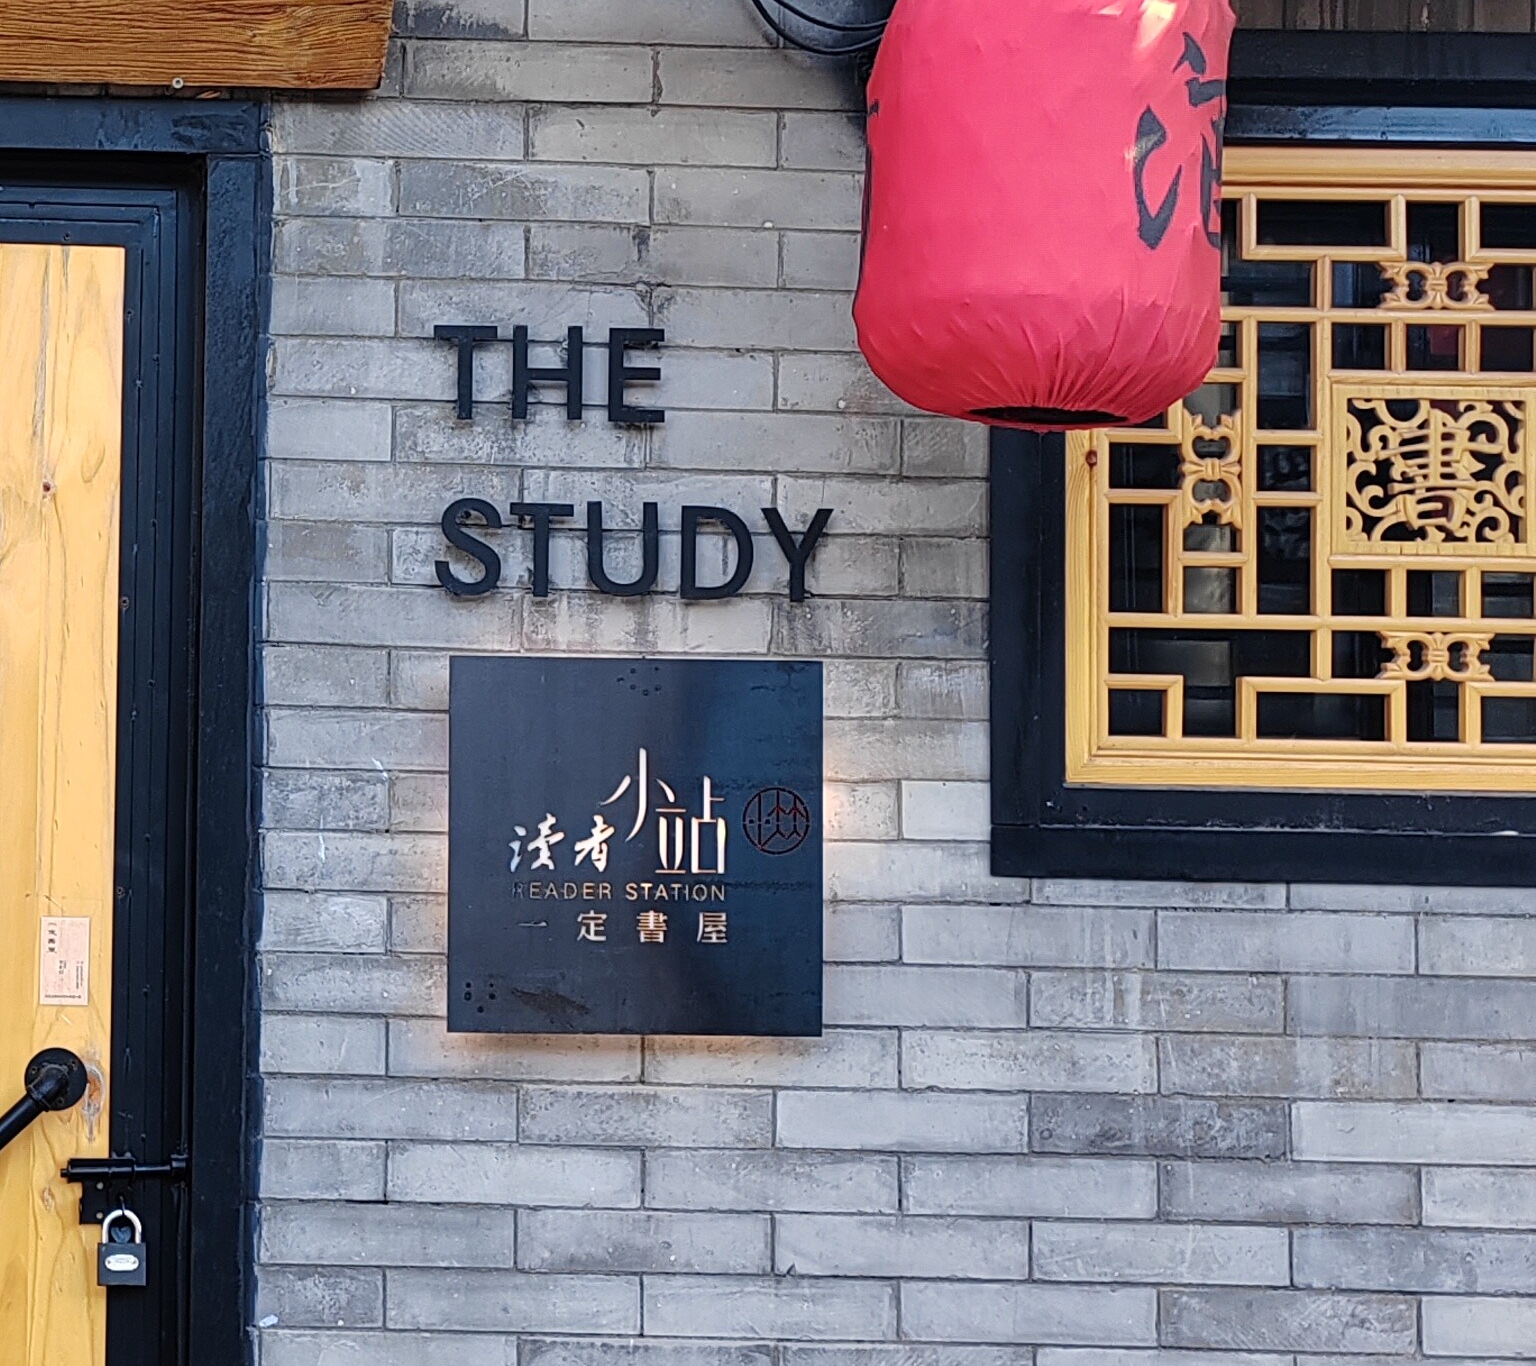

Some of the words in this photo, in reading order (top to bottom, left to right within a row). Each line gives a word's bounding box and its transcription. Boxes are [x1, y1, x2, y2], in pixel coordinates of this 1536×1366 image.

[434, 325, 666, 423] THE
[434, 498, 835, 602] STUDY
[511, 882, 612, 900] READER
[625, 882, 726, 902] STATION
[518, 909, 728, 944] 一定書屋
